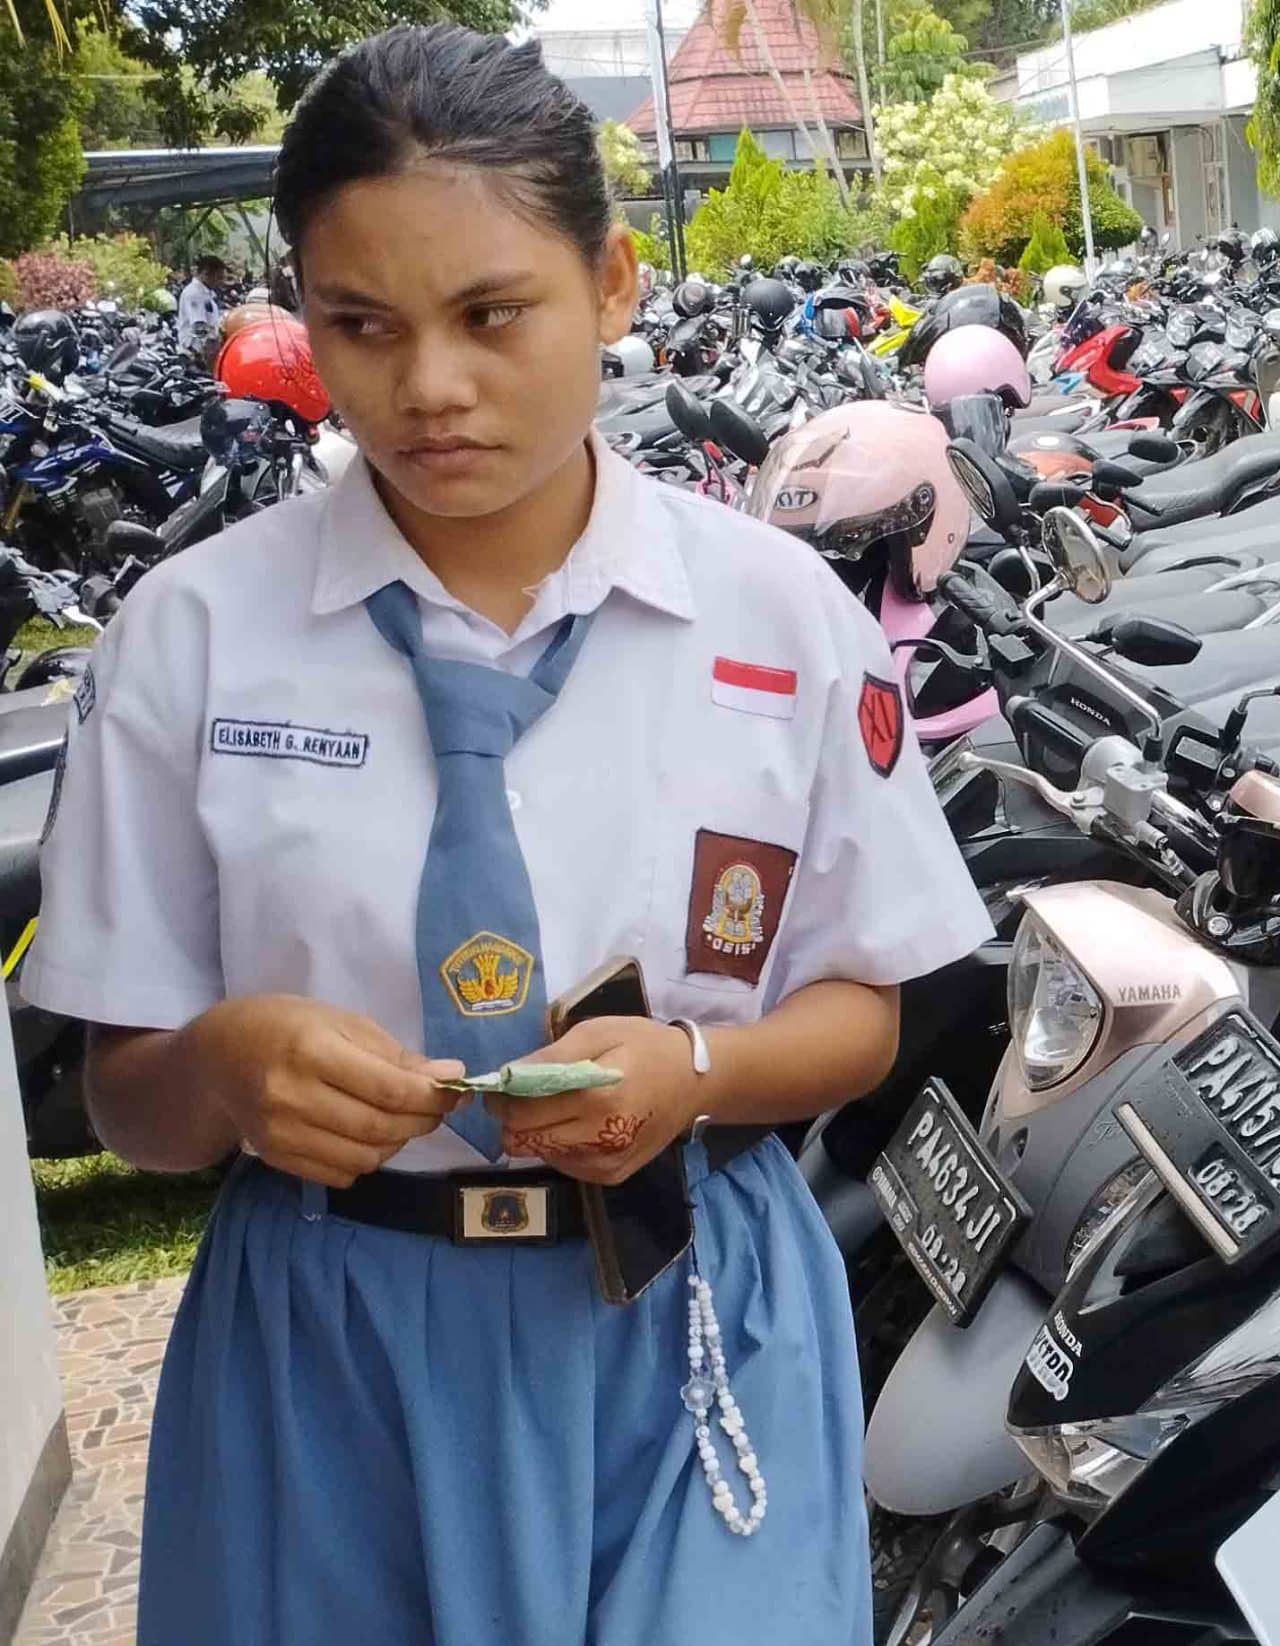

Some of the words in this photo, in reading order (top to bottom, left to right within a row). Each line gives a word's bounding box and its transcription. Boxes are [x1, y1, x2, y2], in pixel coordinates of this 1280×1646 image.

[774, 490, 811, 507] KYT
[1070, 696, 1112, 728] HONDA
[218, 727, 281, 750] ELISABETH
[285, 734, 299, 750] G.
[303, 735, 360, 760] RENYAAN
[1118, 983, 1181, 1003] YAMAHA
[1053, 1308, 1083, 1358] HONDA
